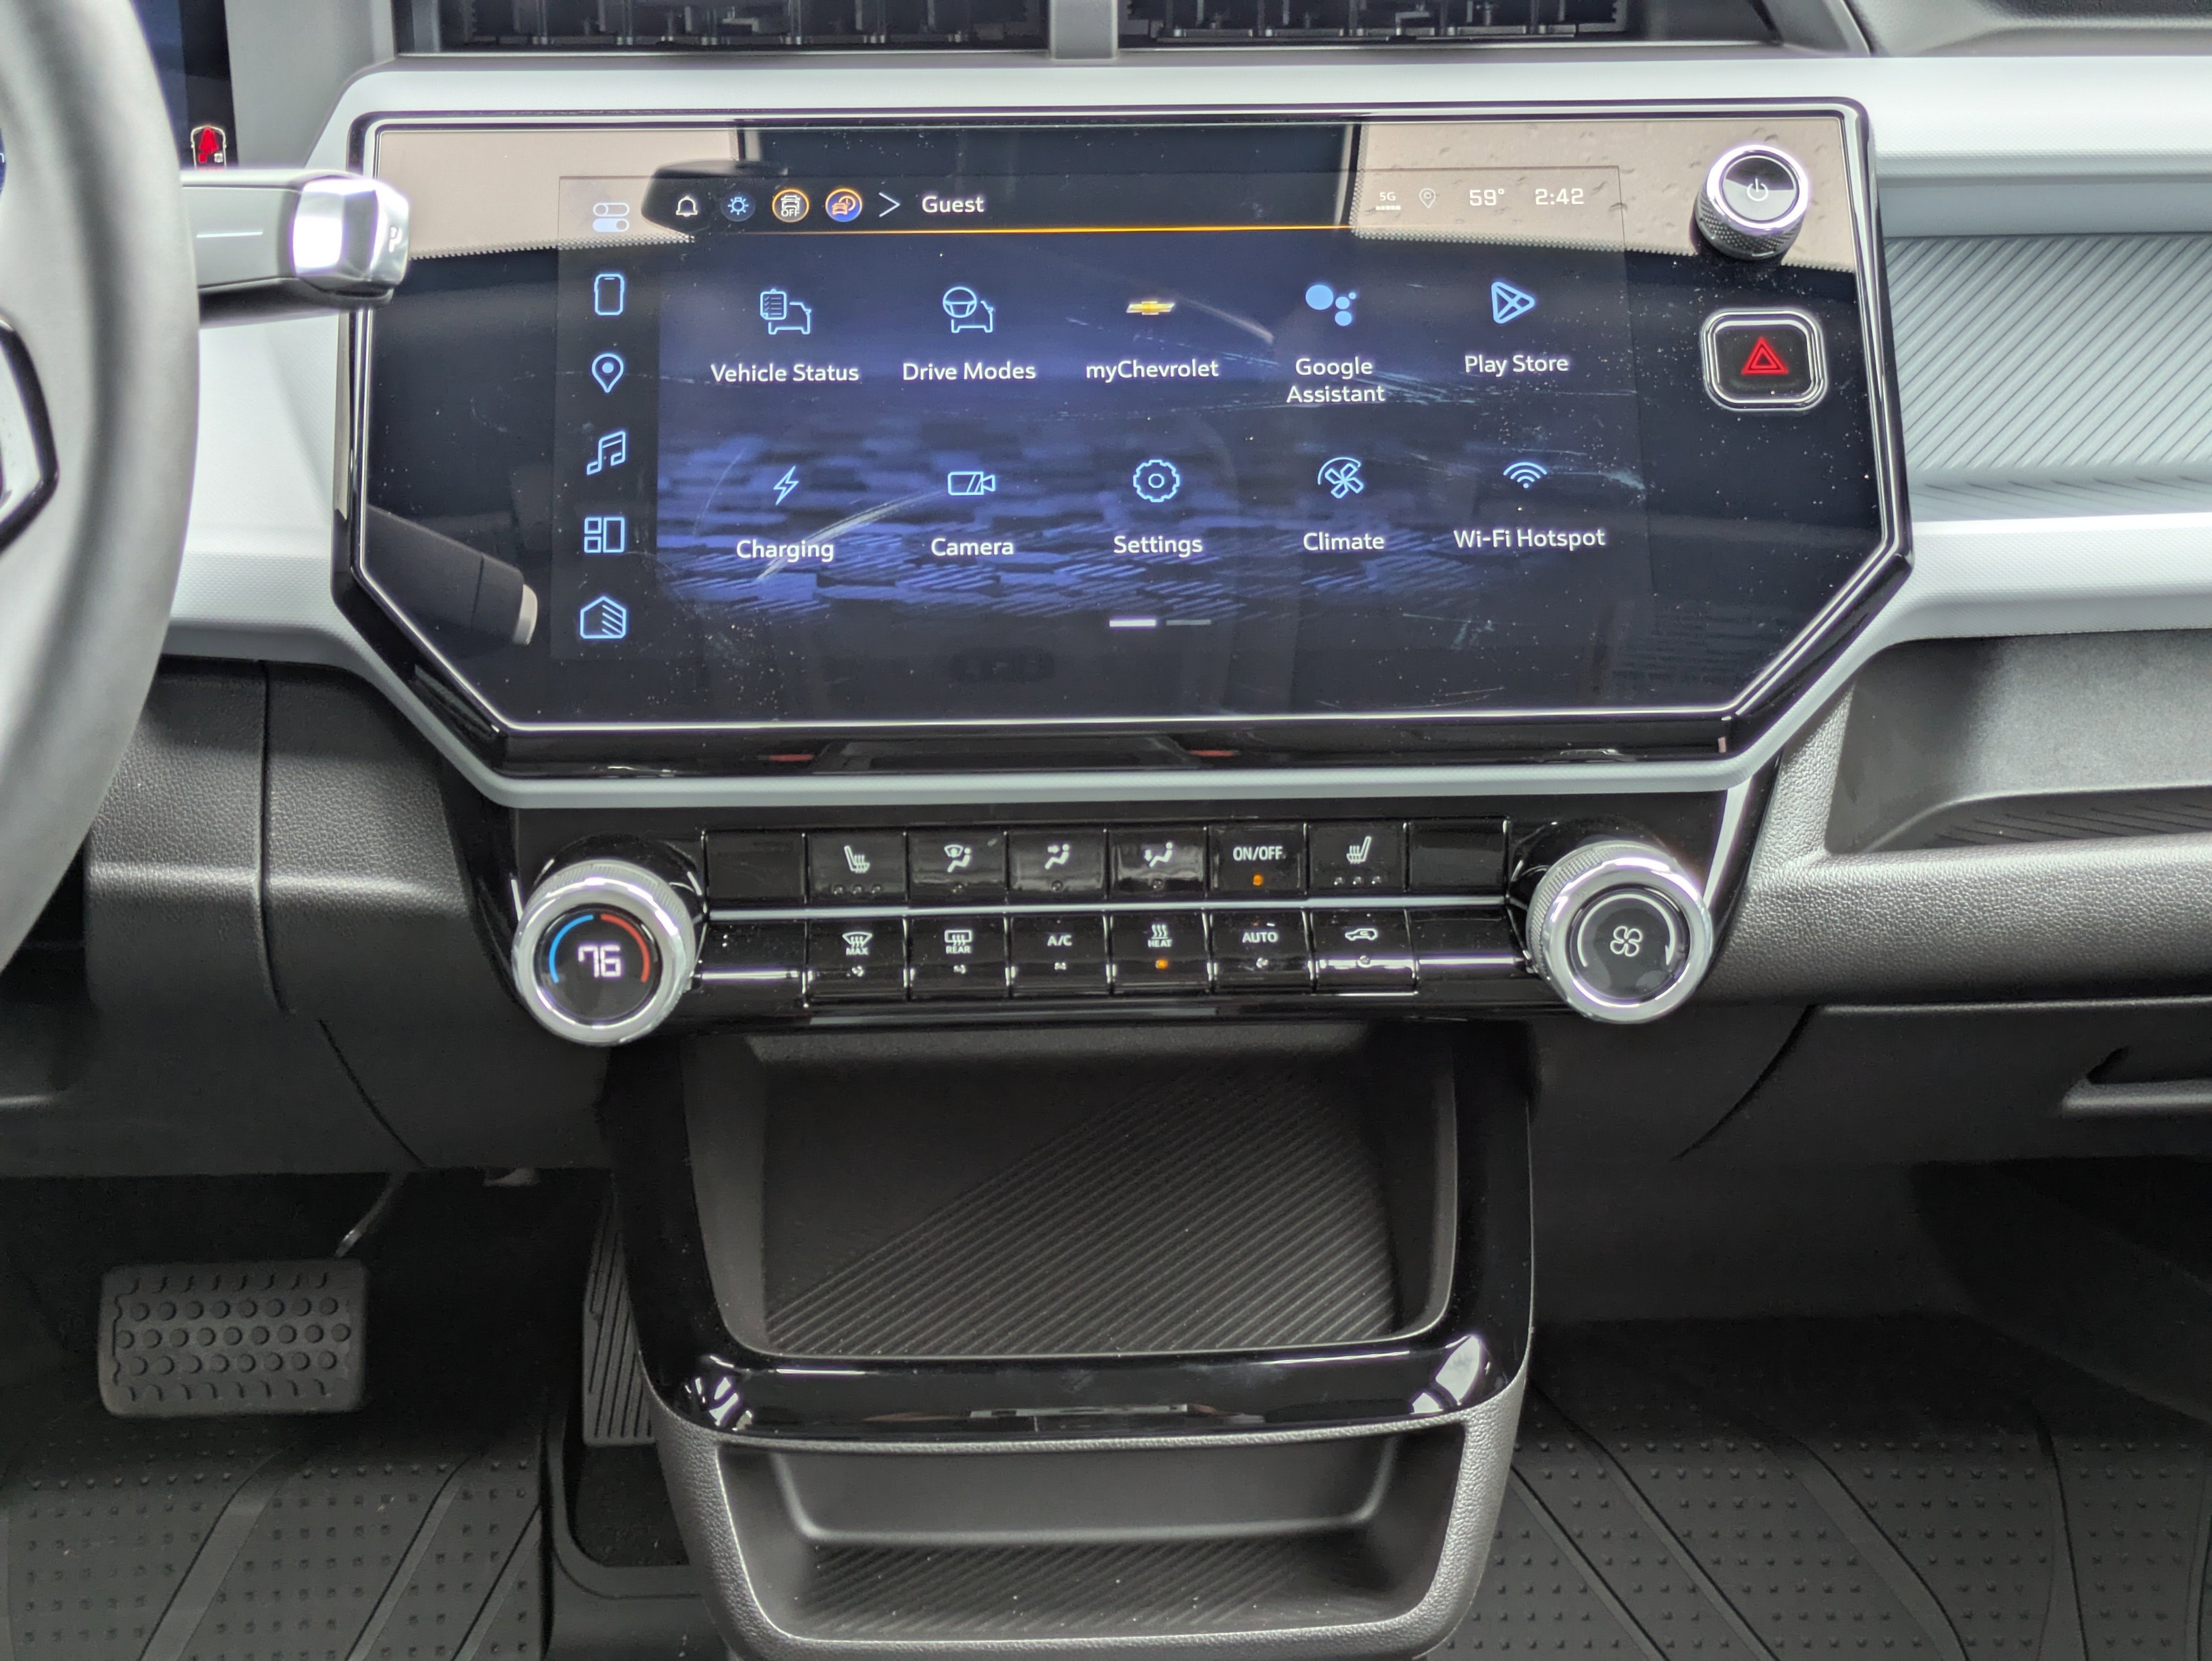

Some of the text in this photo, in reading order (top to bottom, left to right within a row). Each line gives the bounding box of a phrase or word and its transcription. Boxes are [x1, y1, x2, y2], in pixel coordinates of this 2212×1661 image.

[921, 195, 984, 213] Guest
[1379, 191, 1396, 201] 5G
[1469, 188, 1505, 206] 59°
[1535, 188, 1584, 205] 2:42
[781, 209, 800, 217] OFF
[388, 226, 403, 253] P
[710, 362, 860, 383] Vehicle Status
[903, 360, 1037, 381] Drive Modes
[1086, 358, 1219, 384] myChevrolet
[1295, 356, 1373, 380] Google
[1464, 354, 1570, 377] Play Store
[1286, 385, 1386, 403] Assistant
[930, 537, 1014, 557] Camera
[1113, 535, 1203, 557] Settings
[1303, 531, 1385, 551] Climate
[1453, 528, 1606, 552] Wi-Fi Hotspot
[736, 538, 834, 563] Charging
[1232, 845, 1283, 861] ON/OFF
[1047, 934, 1073, 947] A/C
[1147, 939, 1172, 948] HEAT
[1242, 931, 1279, 943] AUTO
[845, 947, 869, 956] MAX
[945, 946, 971, 954] REAR
[577, 944, 622, 978] 76
